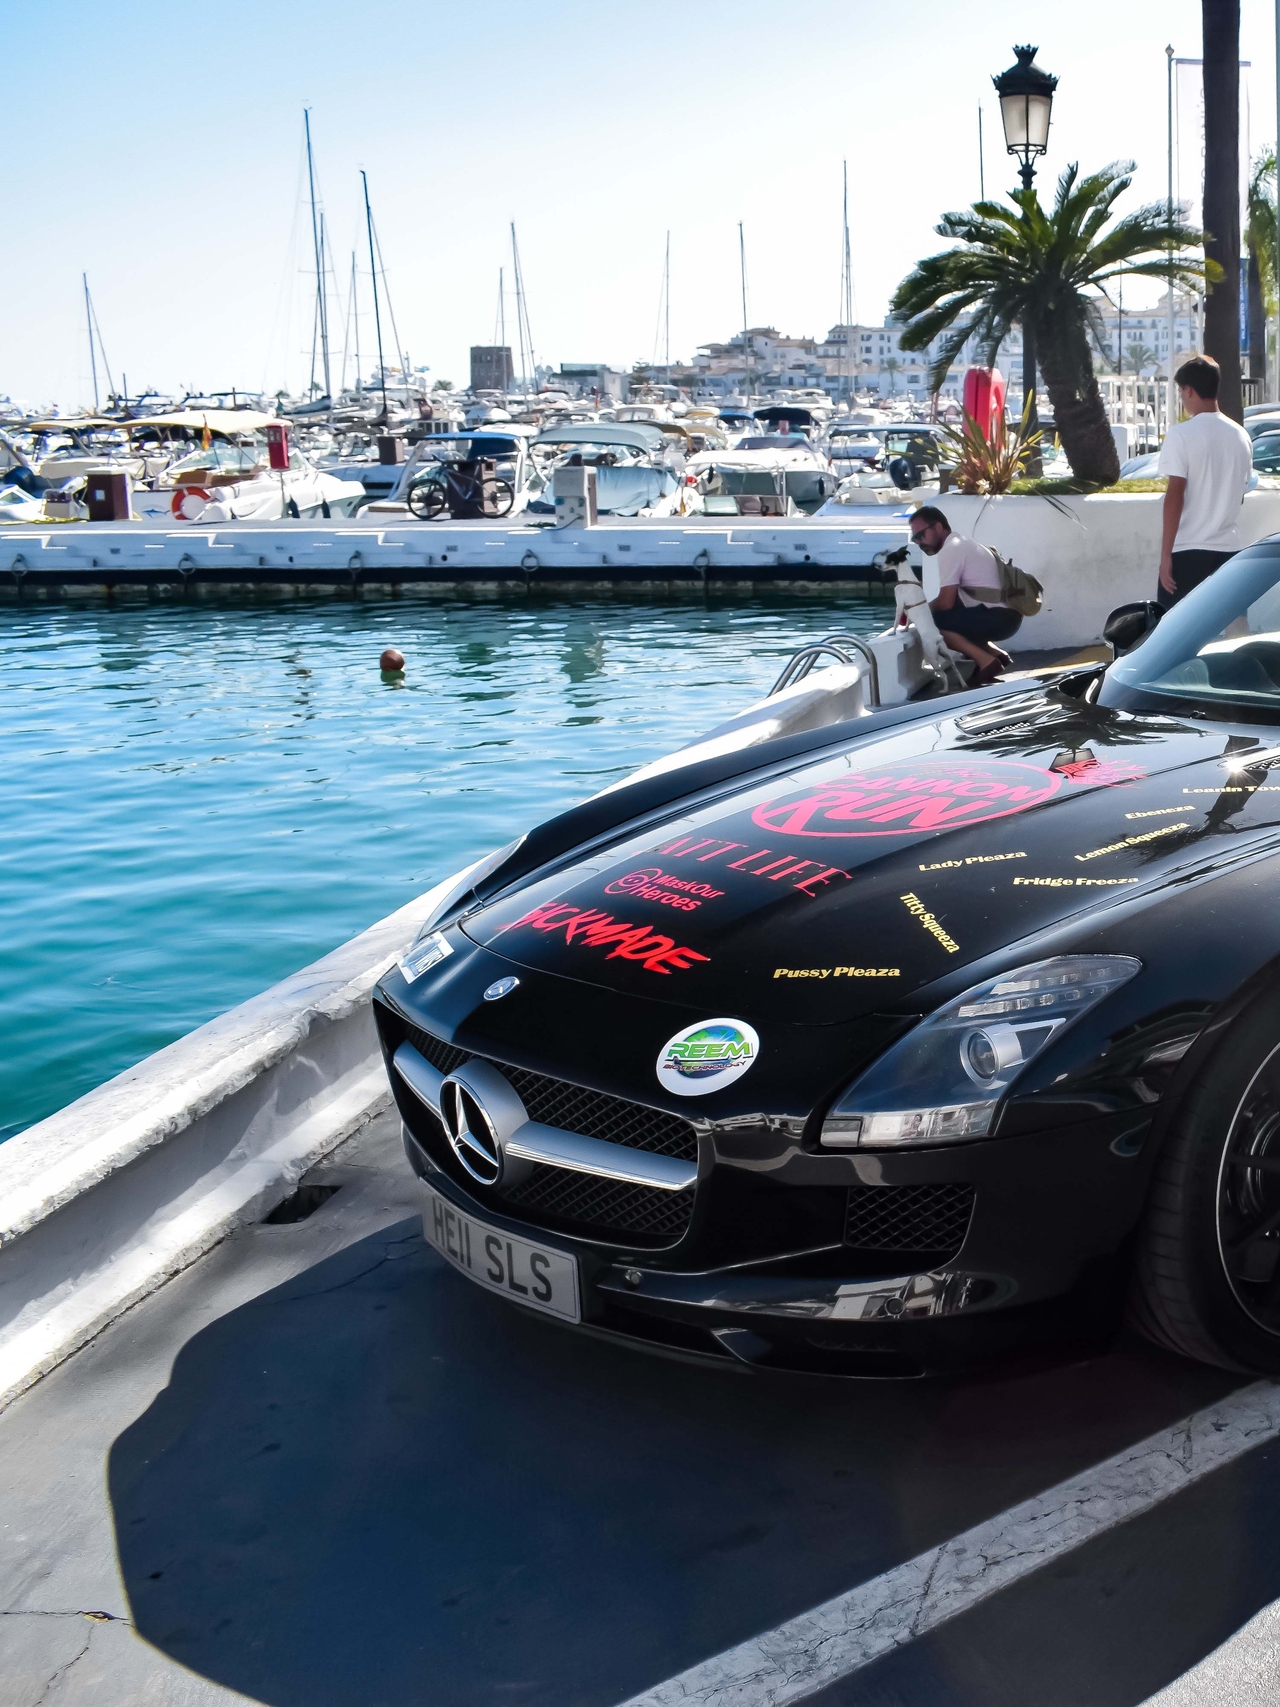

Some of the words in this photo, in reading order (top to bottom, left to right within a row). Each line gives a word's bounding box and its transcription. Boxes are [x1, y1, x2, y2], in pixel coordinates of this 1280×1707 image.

[813, 774, 1054, 801] CANNON
[779, 791, 996, 832] RUN
[1125, 803, 1196, 820] Ebeneza
[1075, 839, 1130, 863] Lemon
[1126, 821, 1190, 845] Squeeza
[727, 849, 853, 898] LIFE
[918, 858, 963, 872] Lady
[965, 850, 1028, 865] Pleaza
[1012, 877, 1074, 888] Fridge
[1075, 876, 1140, 886] Freeza
[632, 883, 703, 911] Heroes
[900, 892, 927, 916] Titty
[919, 911, 960, 954] Squeeza
[773, 967, 831, 980] Pussy
[833, 964, 901, 978] Pleaza
[666, 1041, 751, 1059] REEM
[663, 1060, 747, 1072] BIOTECHNOLOGY
[485, 1234, 553, 1302] SLS
